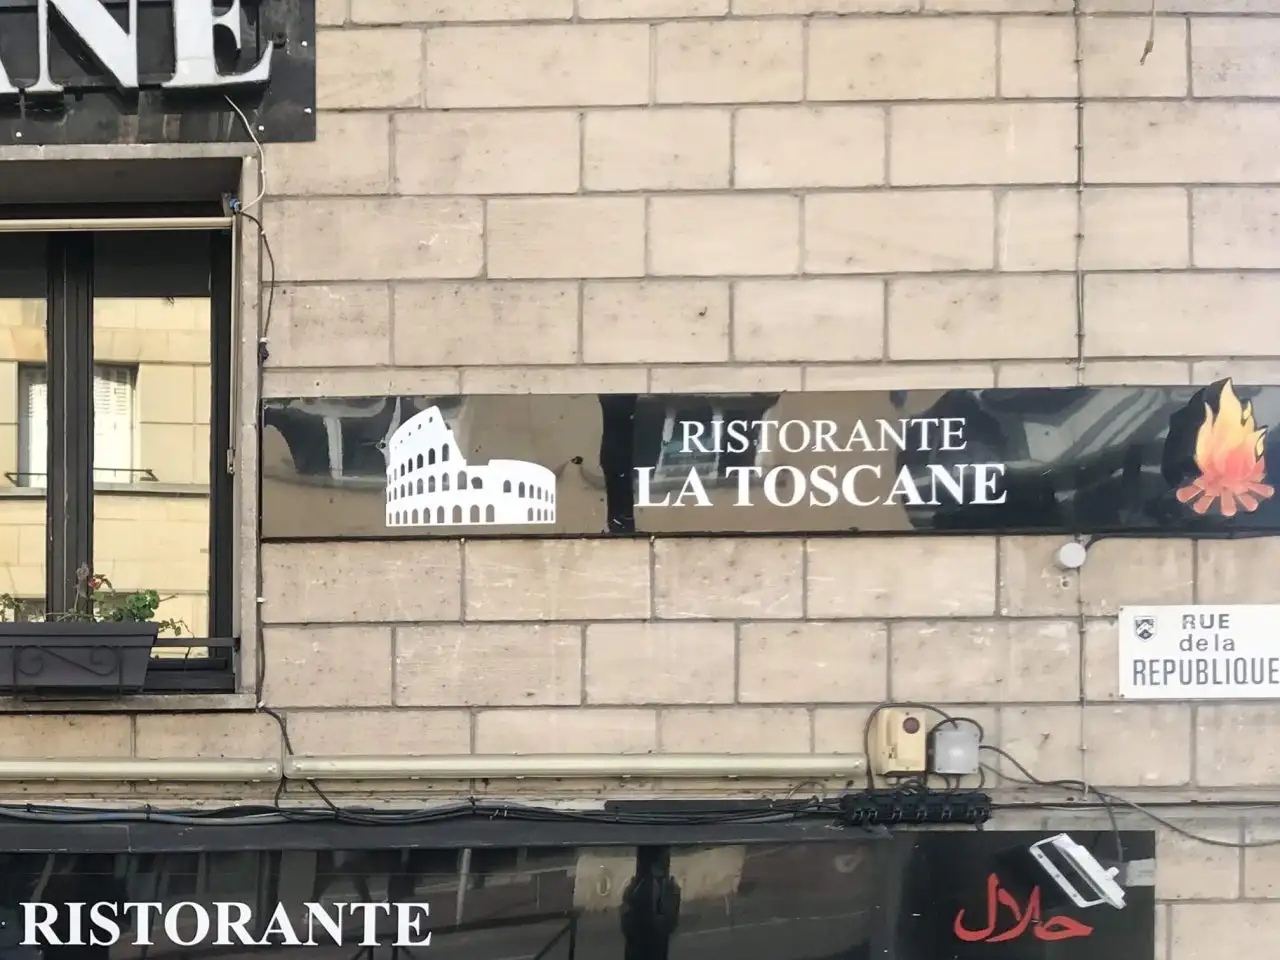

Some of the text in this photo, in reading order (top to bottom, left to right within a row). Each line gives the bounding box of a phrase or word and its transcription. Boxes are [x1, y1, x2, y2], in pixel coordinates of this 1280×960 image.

[678, 416, 968, 454] RISTORANTE
[633, 461, 1008, 509] LA TOSCANE
[1182, 613, 1230, 630] RUE
[1179, 633, 1236, 652] de la
[1132, 657, 1280, 686] REPUBLIQUE
[18, 900, 433, 947] RISTORANTE
[953, 873, 1096, 943] حلال
